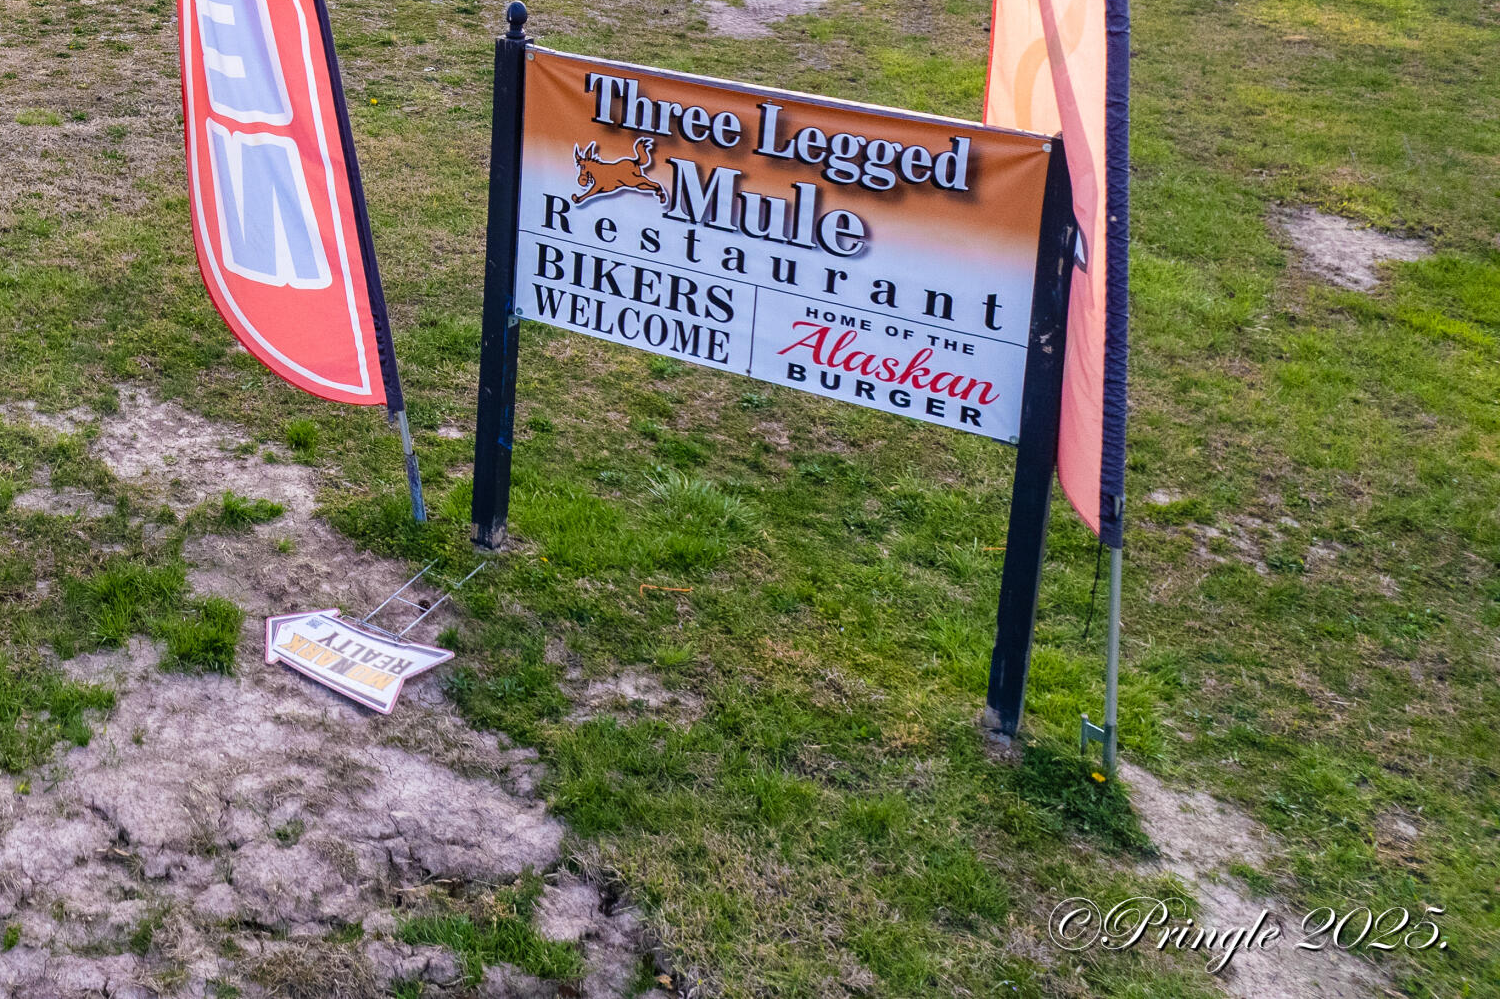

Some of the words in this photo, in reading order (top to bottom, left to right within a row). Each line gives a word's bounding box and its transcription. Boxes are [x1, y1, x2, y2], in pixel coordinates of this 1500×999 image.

[585, 72, 741, 148] Three
[754, 102, 971, 191] Legged
[663, 157, 866, 257] Mule
[534, 242, 735, 323] BIKERS
[541, 193, 1002, 331] Restaurant
[532, 282, 730, 364] WELCOME
[776, 320, 1000, 405] Alaskan
[806, 306, 872, 331] HOME
[885, 325, 914, 340] OF
[927, 334, 975, 355] THE
[787, 362, 983, 428] BURGER
[278, 633, 399, 691] MONARK
[314, 631, 414, 675] REALTY
